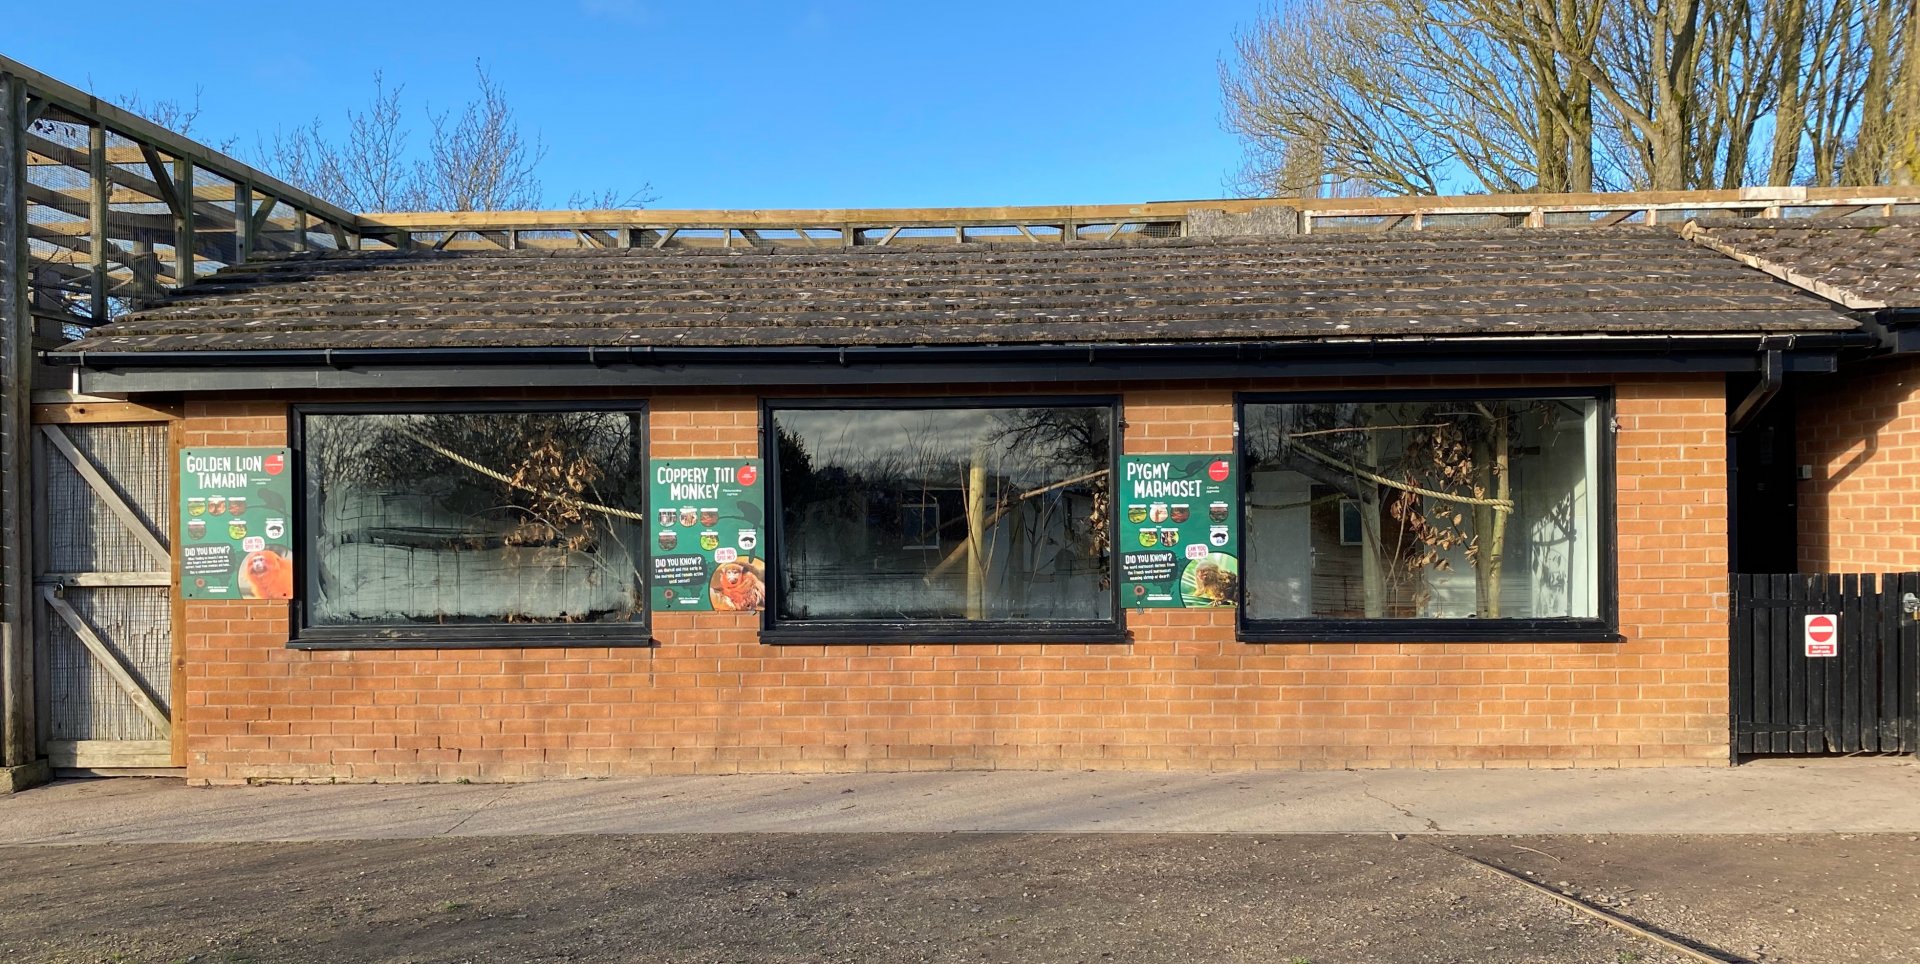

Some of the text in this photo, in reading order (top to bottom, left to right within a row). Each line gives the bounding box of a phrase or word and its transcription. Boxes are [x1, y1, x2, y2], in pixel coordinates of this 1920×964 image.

[186, 456, 262, 473] GOLDEN LION
[1127, 462, 1170, 481] PYGMY
[197, 472, 248, 490] TAMARIN
[657, 466, 734, 484] COPPERY TITI
[670, 483, 720, 500] MONKEY
[1134, 480, 1202, 498] MARMOSET
[185, 546, 230, 557] DID YOU KNOW?
[1125, 553, 1172, 564] DID YOU KNOW?
[655, 557, 702, 568] DID YOU KNOW?
